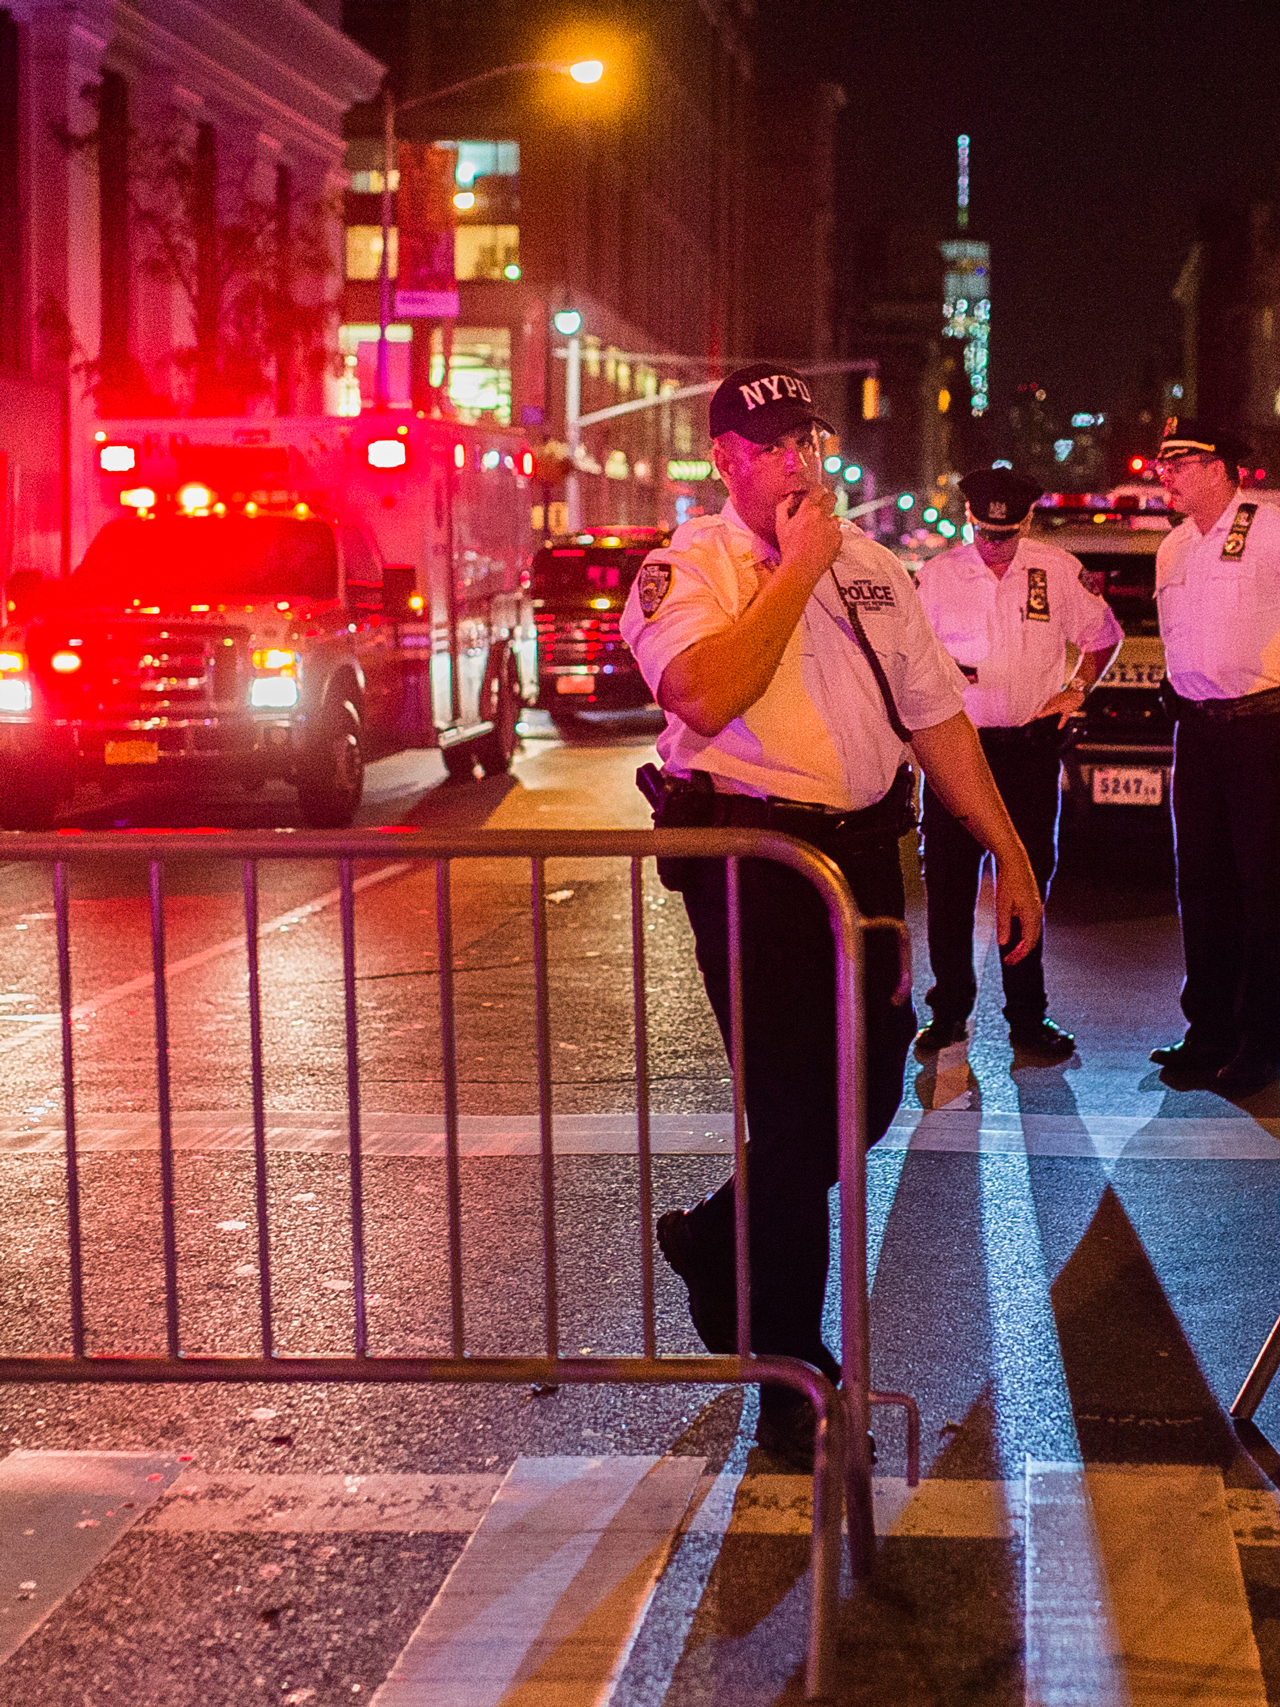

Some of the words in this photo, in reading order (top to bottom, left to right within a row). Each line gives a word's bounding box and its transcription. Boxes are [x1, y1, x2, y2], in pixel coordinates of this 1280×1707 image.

[739, 375, 811, 410] NYPD
[840, 586, 893, 601] POLICE
[1102, 664, 1162, 683] OLIC
